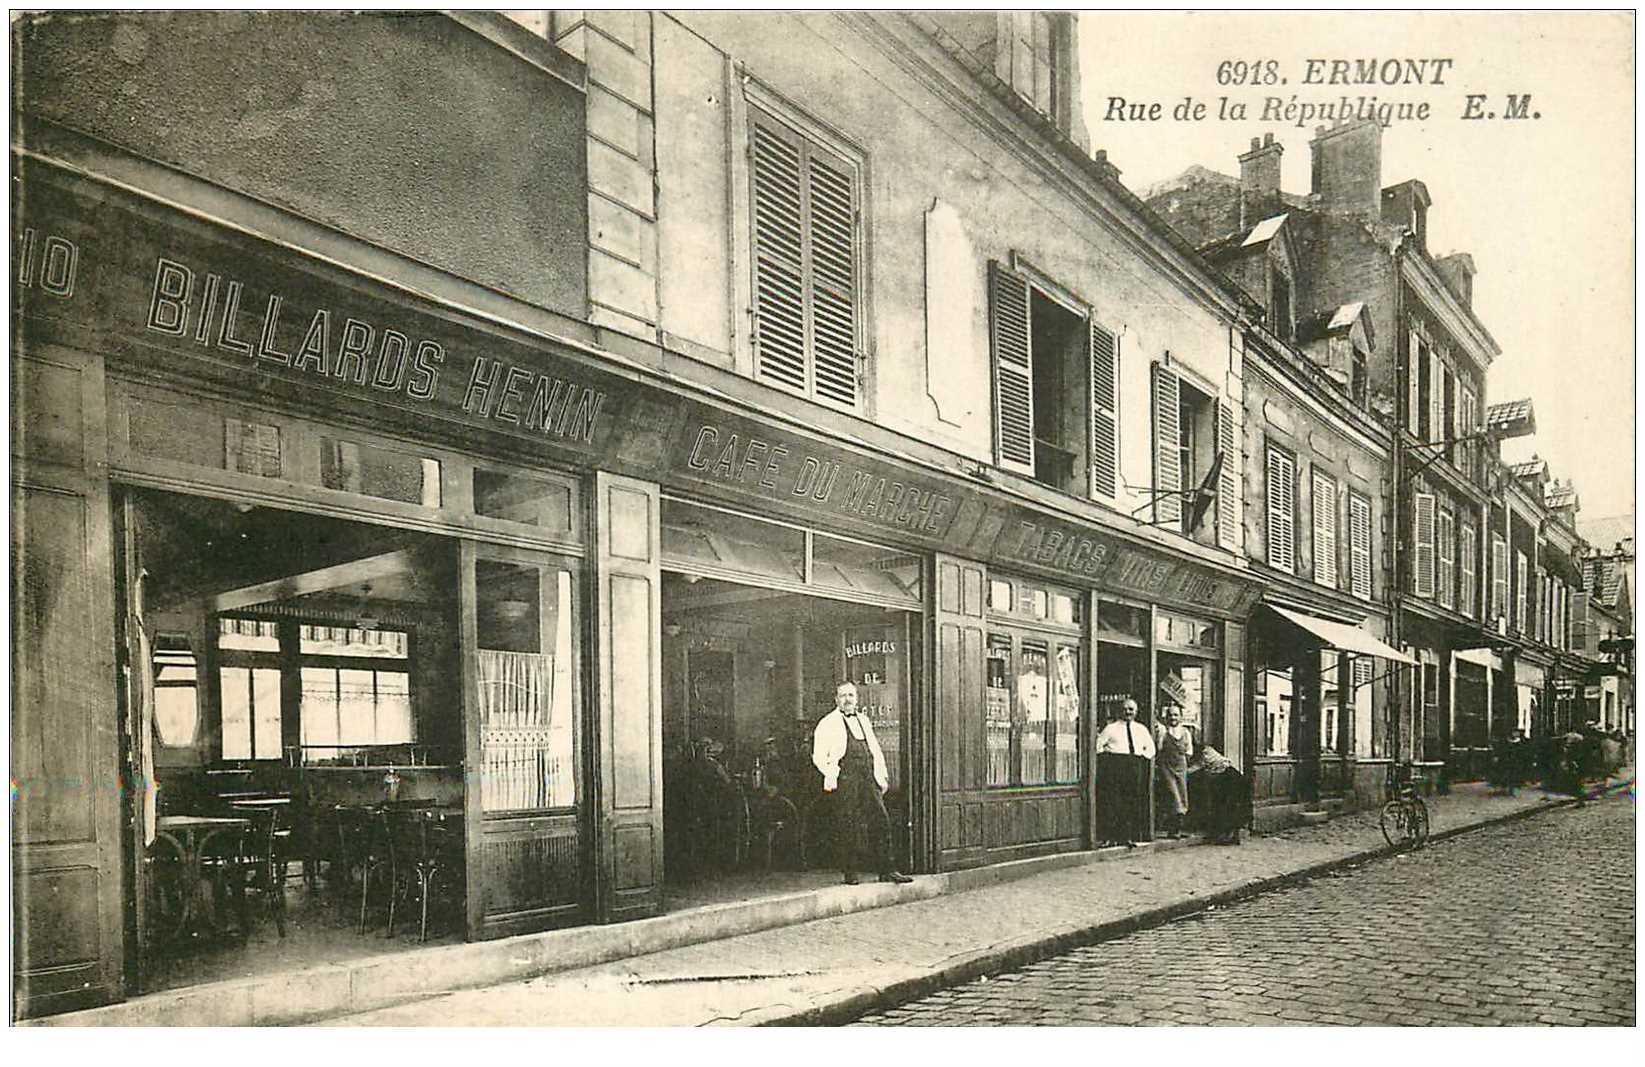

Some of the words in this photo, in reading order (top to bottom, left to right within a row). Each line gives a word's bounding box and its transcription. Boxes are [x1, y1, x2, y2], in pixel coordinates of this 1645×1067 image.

[147, 257, 446, 401] BILLARDS
[462, 355, 608, 445] HENIN
[792, 456, 841, 502] DU
[846, 641, 896, 659] BILLARDS
